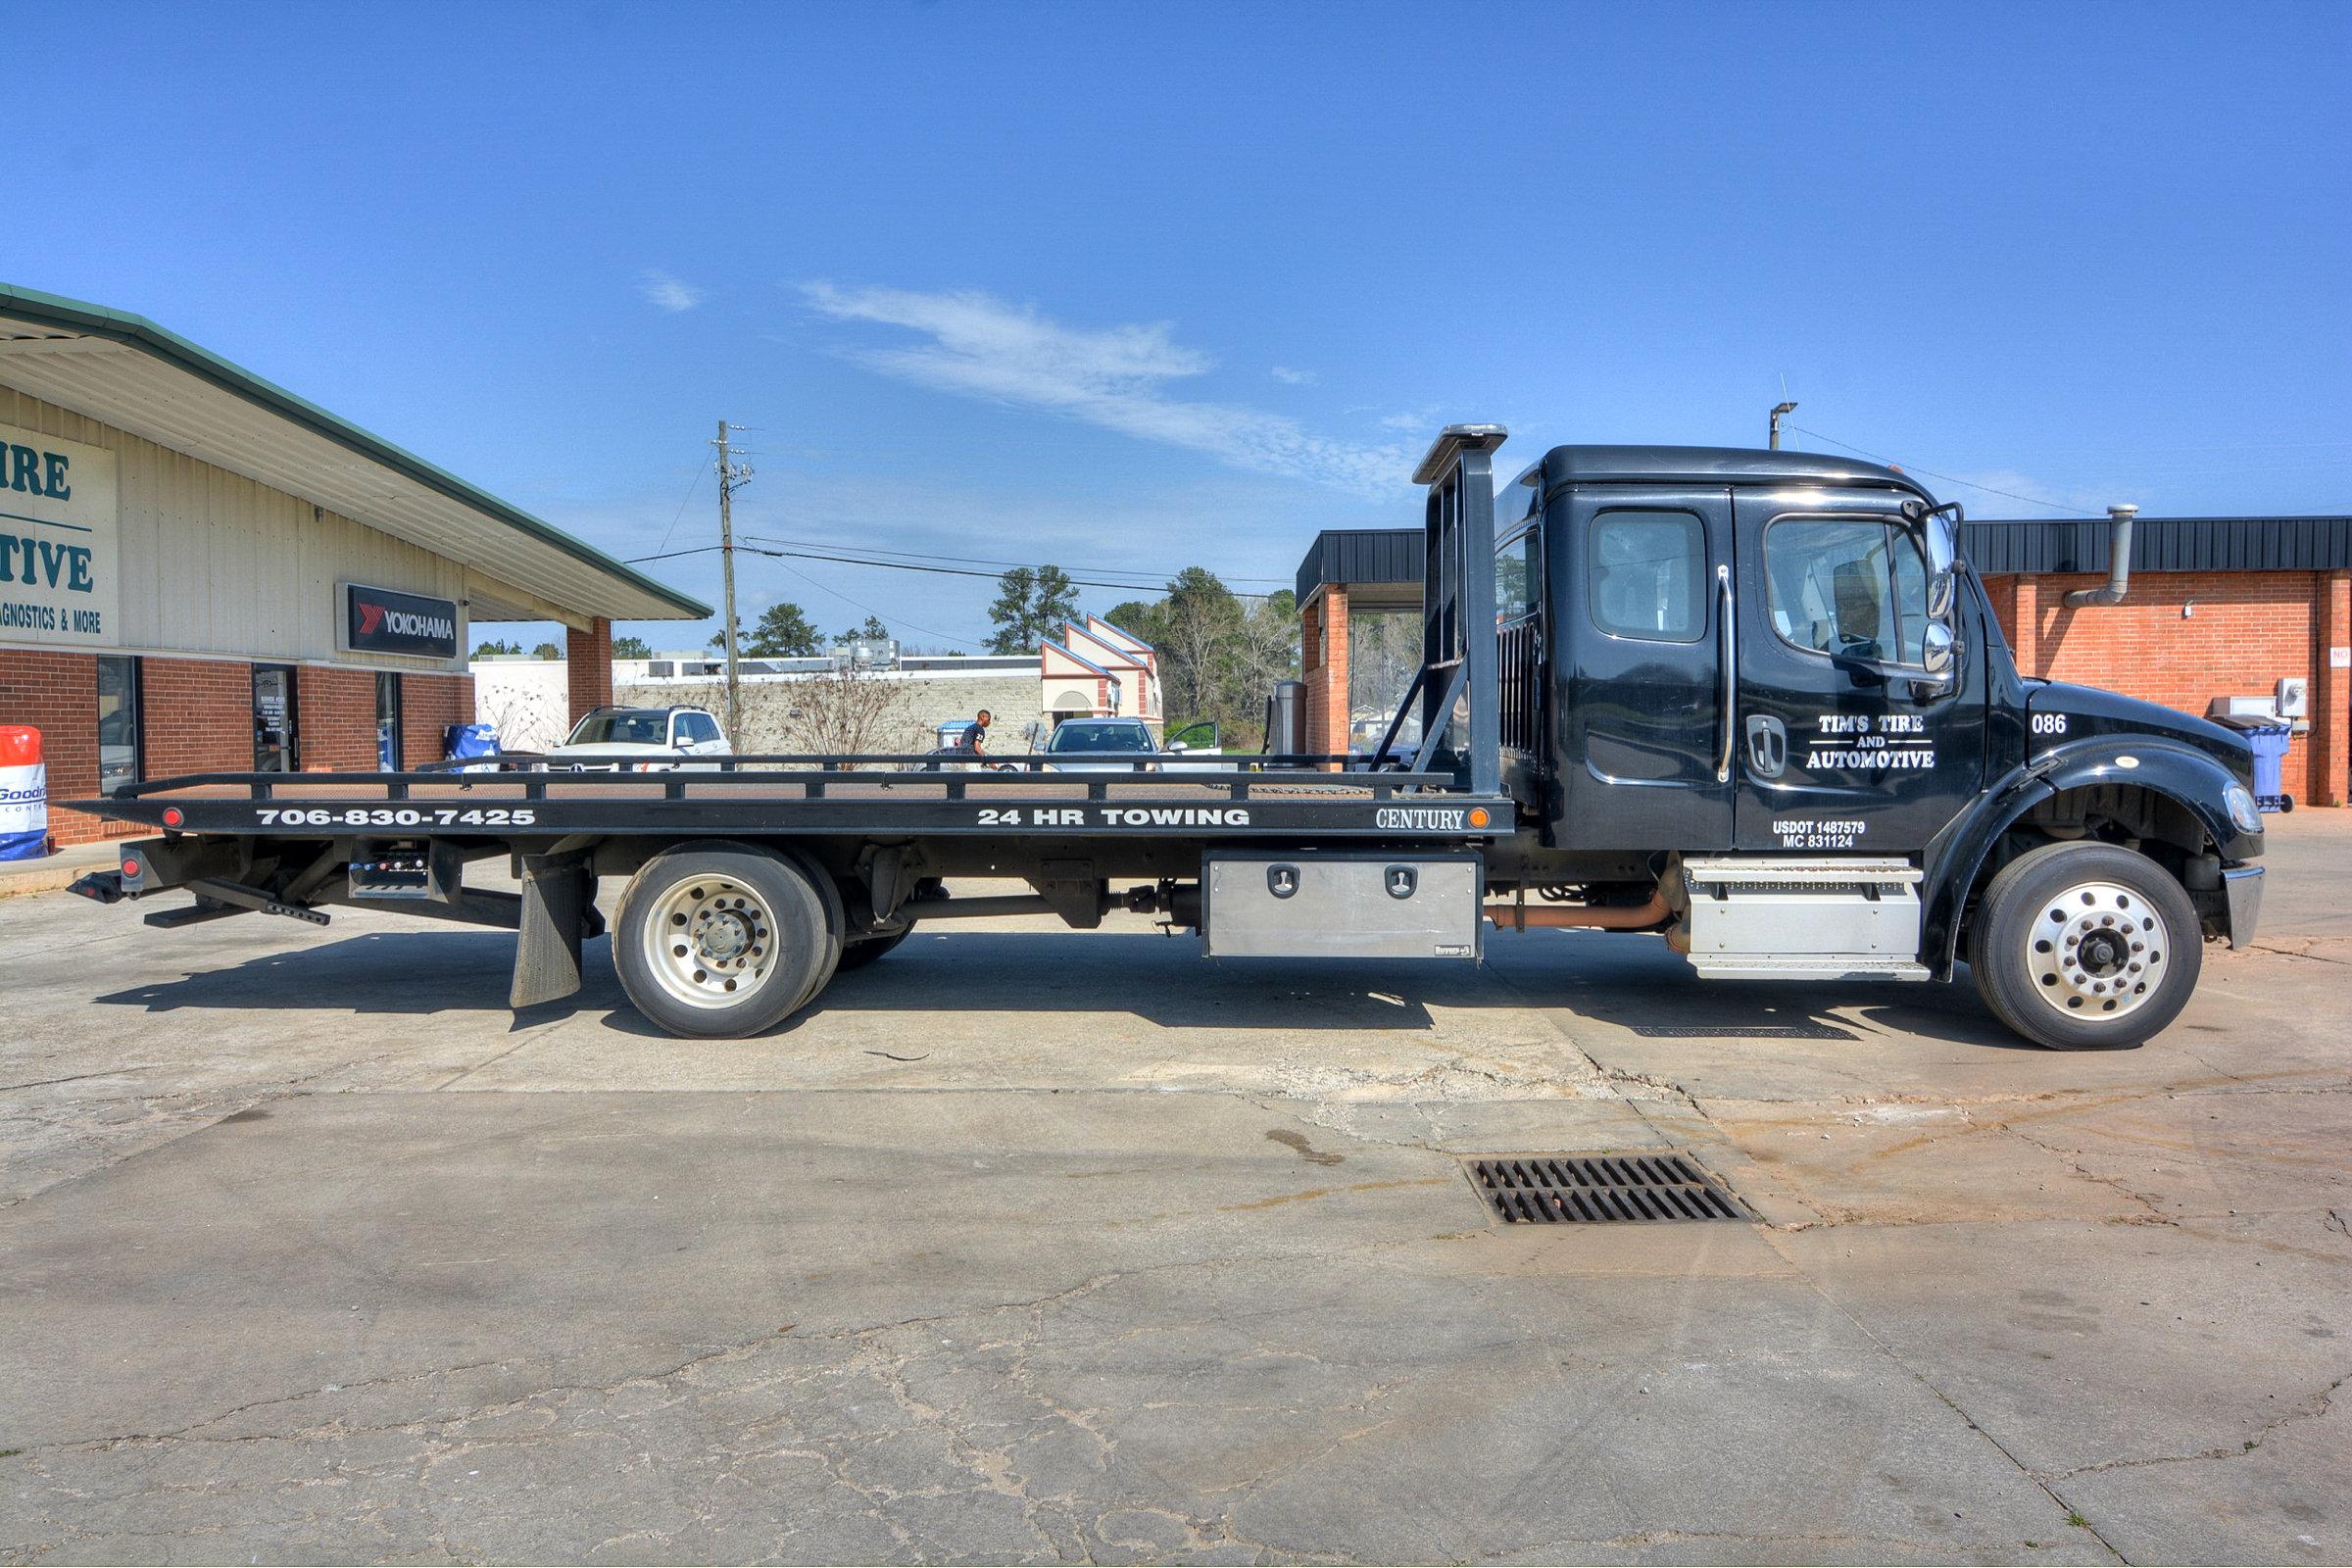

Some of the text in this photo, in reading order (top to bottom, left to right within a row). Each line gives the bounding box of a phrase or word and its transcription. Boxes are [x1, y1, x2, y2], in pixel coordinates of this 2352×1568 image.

[61, 609, 69, 631] &
[74, 610, 101, 634] MORE
[384, 610, 454, 640] YOKOHAMA
[1818, 714, 1924, 733] TIM'S TIRE
[2032, 713, 2067, 734] 086
[1856, 736, 1886, 749] AND
[1806, 751, 1936, 769] AUTOMOTIVE
[256, 809, 536, 825] 706-830-7425
[978, 808, 1250, 826] 24 HR TOWING
[1376, 808, 1465, 830] CENTURY
[1773, 820, 1866, 834] USDOT 1487579
[1783, 835, 1853, 848] MC 831124
